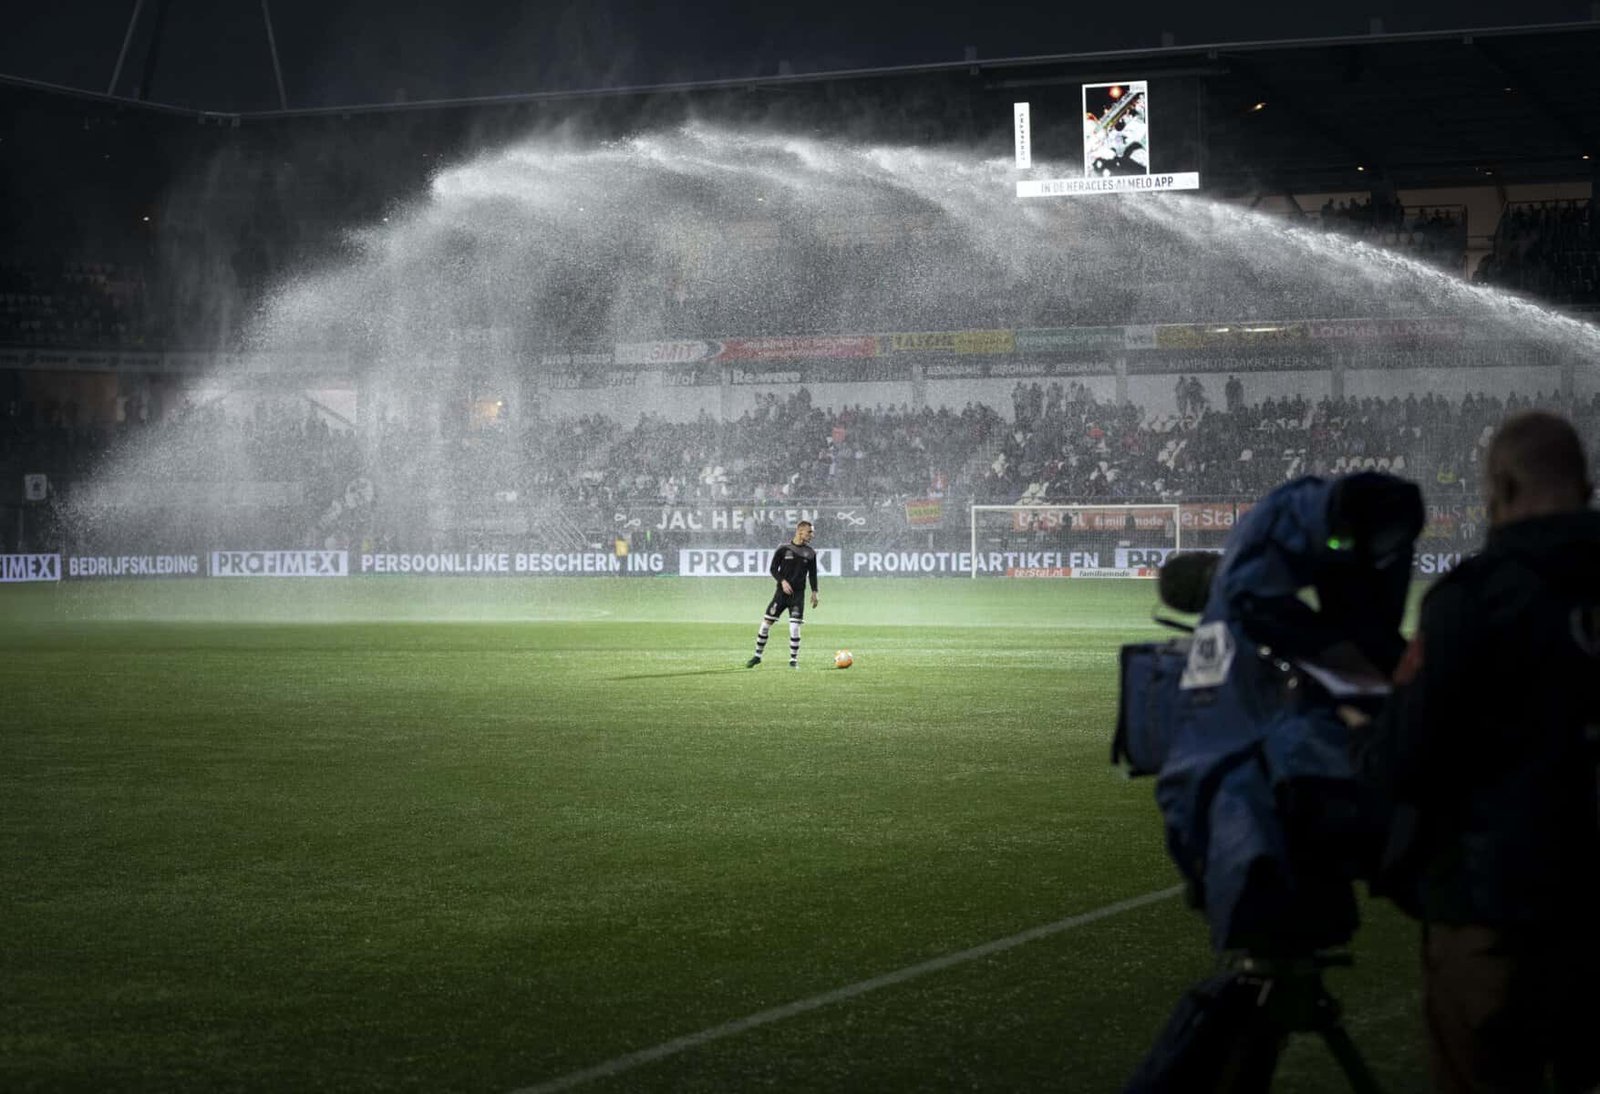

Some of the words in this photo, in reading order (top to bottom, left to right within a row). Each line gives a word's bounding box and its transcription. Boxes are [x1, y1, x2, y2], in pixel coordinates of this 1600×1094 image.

[1040, 182, 1051, 194] IN
[1053, 182, 1066, 193] DE
[1066, 179, 1114, 192] HERACLES
[1154, 175, 1174, 188] APP
[656, 509, 703, 530] JAC
[69, 554, 199, 576] BEDRIJFSKLEDING
[218, 551, 343, 576] PROFIMEX
[360, 552, 509, 573] PERSOONLIJKE
